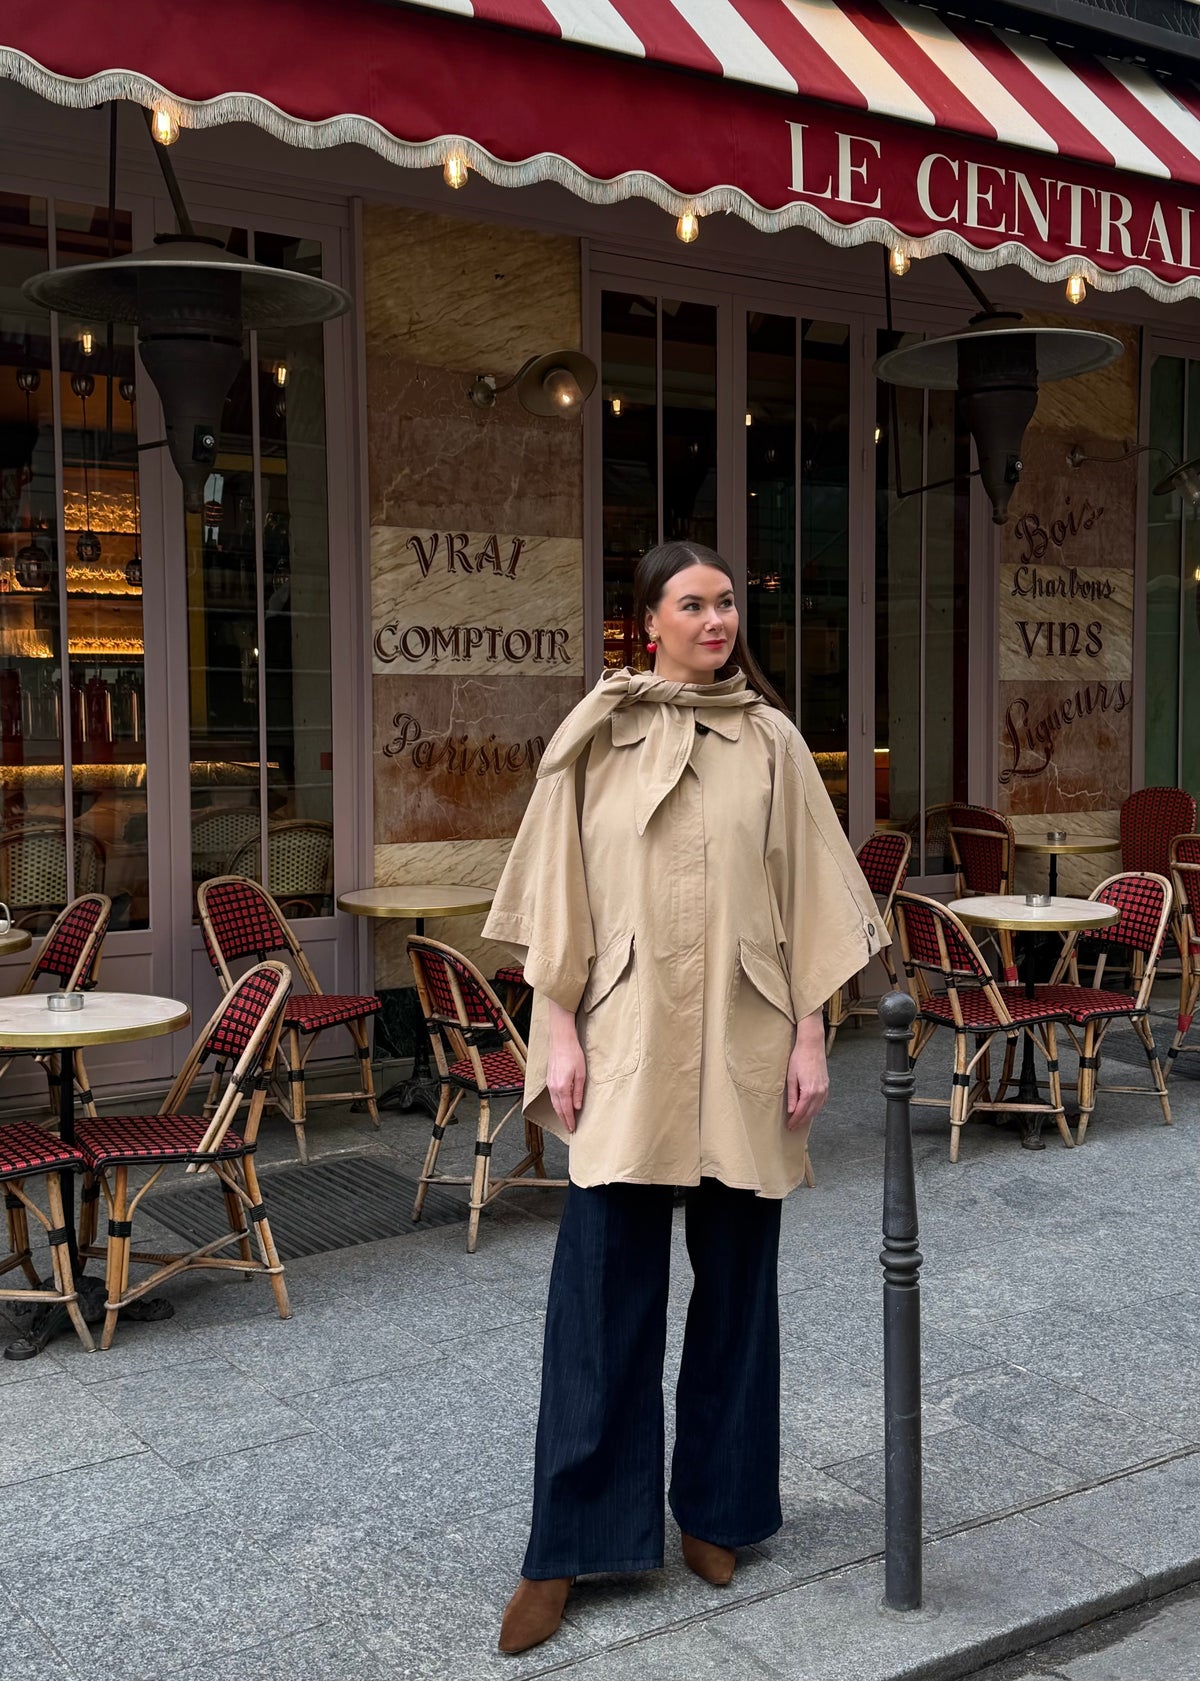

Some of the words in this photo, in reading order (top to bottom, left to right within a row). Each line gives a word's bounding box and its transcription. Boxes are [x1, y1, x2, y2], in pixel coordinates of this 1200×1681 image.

[784, 119, 882, 209] LE
[917, 153, 1200, 270] CENTRAL
[406, 532, 526, 580] VRAI
[1015, 496, 1104, 564] Bois
[1011, 566, 1116, 601] Charbons
[374, 620, 572, 663] COMPTOIR
[998, 681, 1132, 784] Liqueurs
